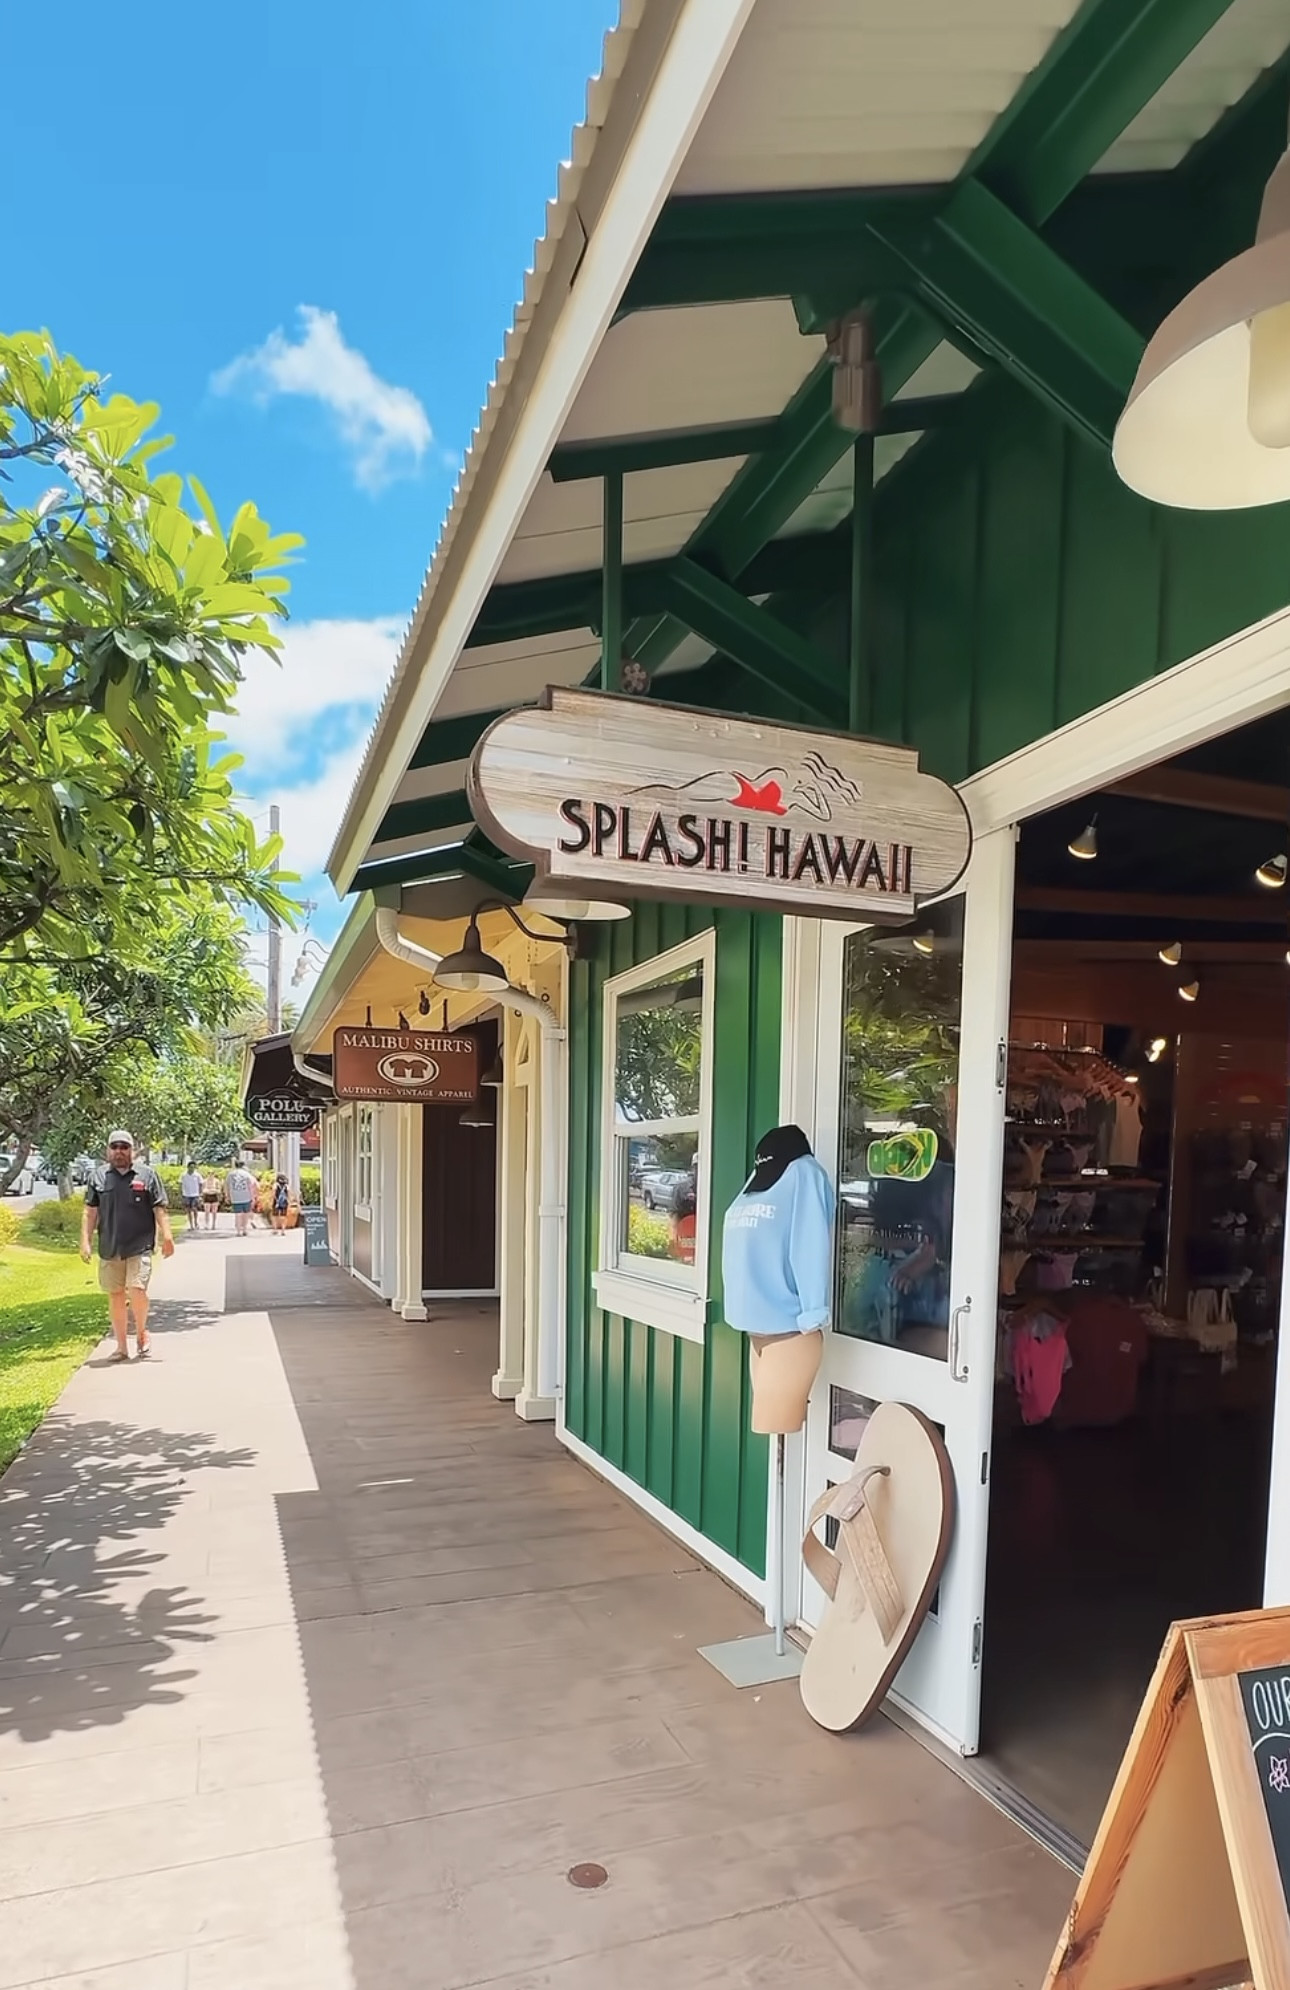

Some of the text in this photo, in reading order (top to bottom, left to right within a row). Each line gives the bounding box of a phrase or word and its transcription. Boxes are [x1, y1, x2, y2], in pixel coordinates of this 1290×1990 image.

[557, 798, 913, 894] SPLASH! HAWAII
[342, 1033, 473, 1054] MALIBU SHIRTS
[341, 1086, 473, 1099] AUTHENTIC VINTAGE APPAREL
[258, 1098, 305, 1112] POLU
[254, 1111, 311, 1123] GALLERY
